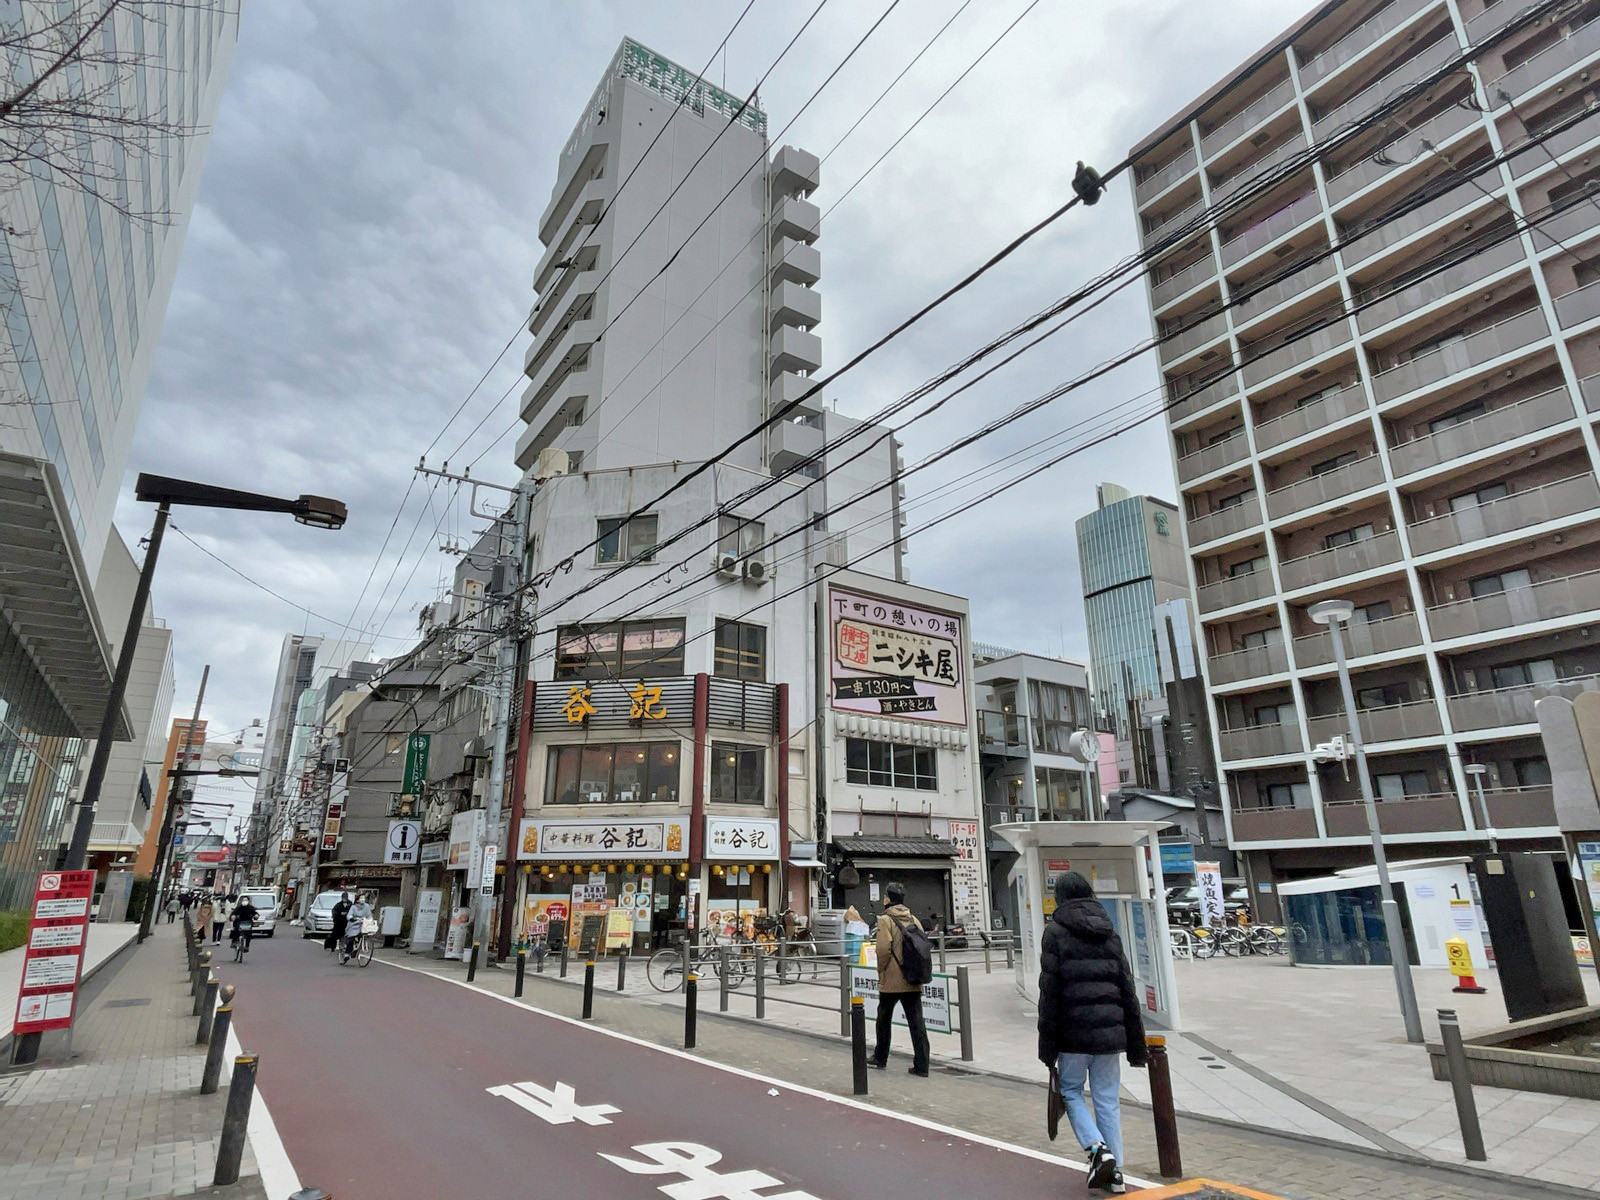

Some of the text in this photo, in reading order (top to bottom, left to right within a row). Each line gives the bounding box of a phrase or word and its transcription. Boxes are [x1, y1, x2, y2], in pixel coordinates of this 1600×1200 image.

[834, 598, 958, 638] 下町の憩いの場
[872, 642, 955, 682] ニシキ屋
[558, 683, 668, 723] 谷記
[549, 827, 648, 850] 中華料理 谷記
[728, 828, 769, 850] 谷記
[952, 836, 977, 848] ゆったり
[390, 851, 412, 862] 無料
[1450, 883, 1461, 900] 1
